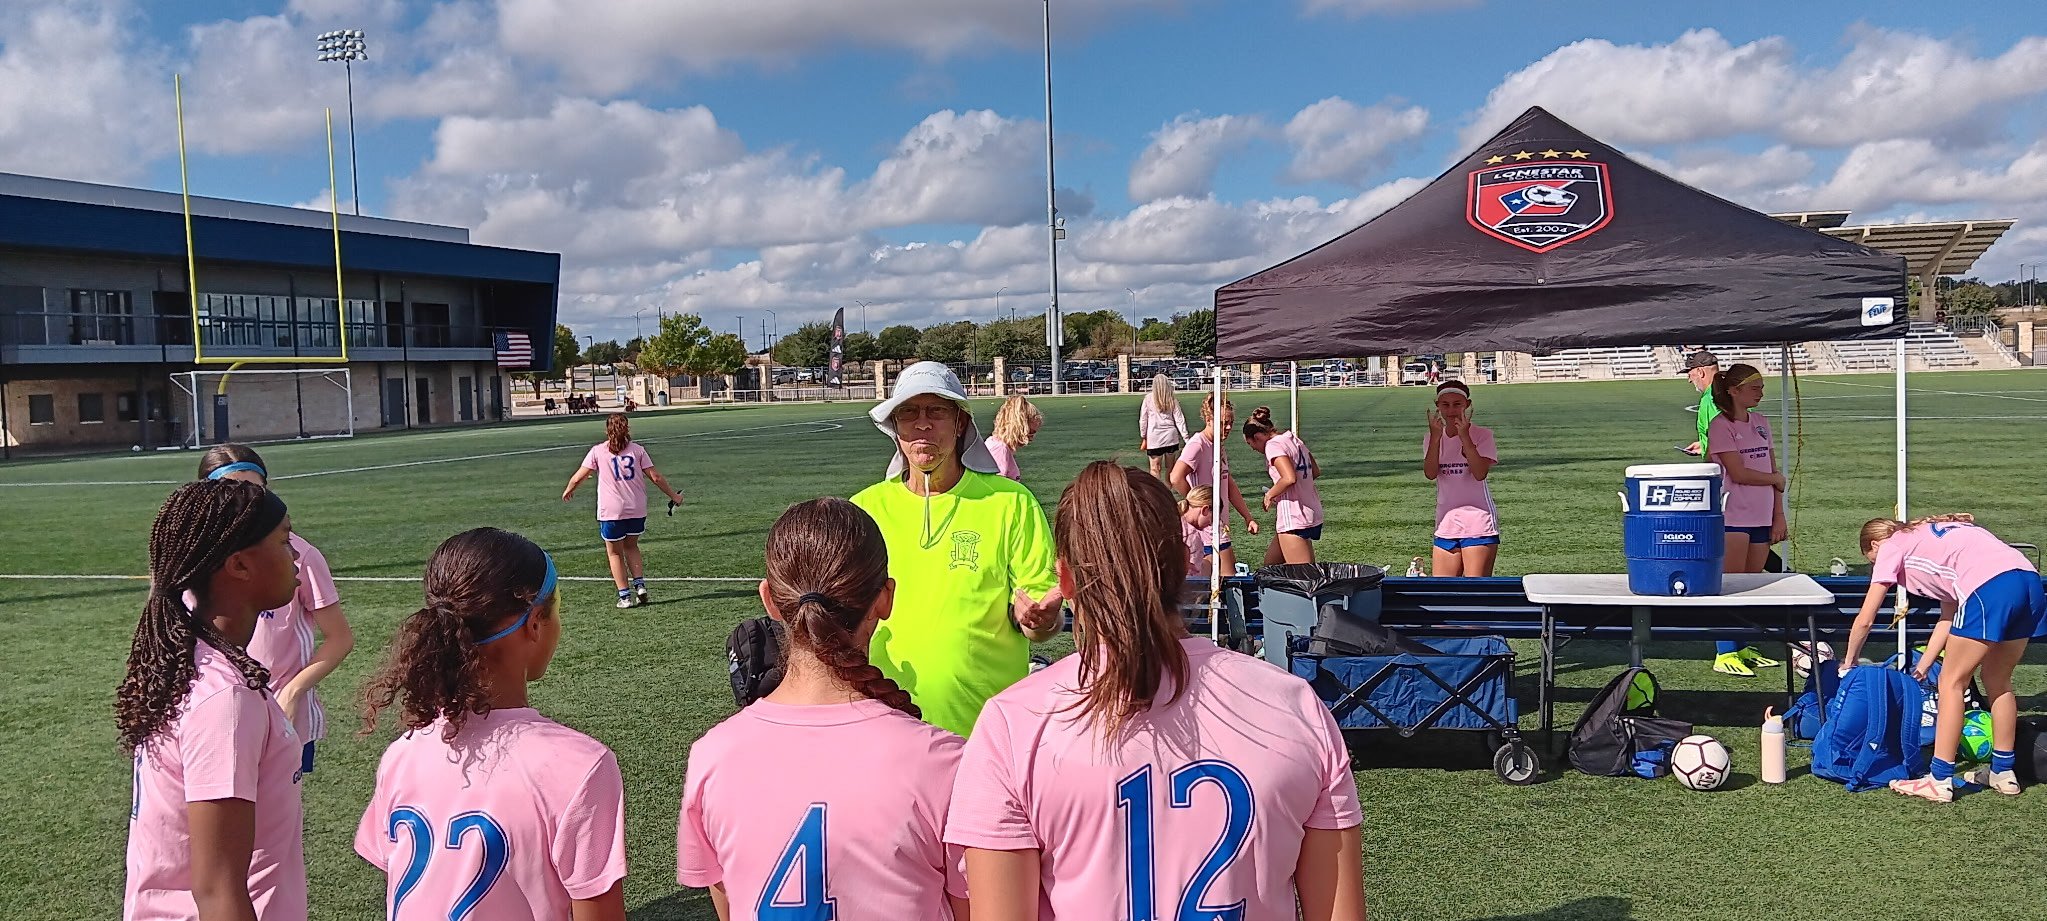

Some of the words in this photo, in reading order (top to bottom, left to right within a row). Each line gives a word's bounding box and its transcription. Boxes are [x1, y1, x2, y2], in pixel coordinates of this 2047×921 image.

[1494, 168, 1582, 179] LONESTAR
[1535, 225, 1568, 233] 2004
[611, 455, 635, 481] 13
[1296, 445, 1312, 480] 4
[1651, 489, 1667, 503] R
[1116, 759, 1256, 921] 12
[388, 806, 510, 921] 22
[755, 802, 838, 921] 4
